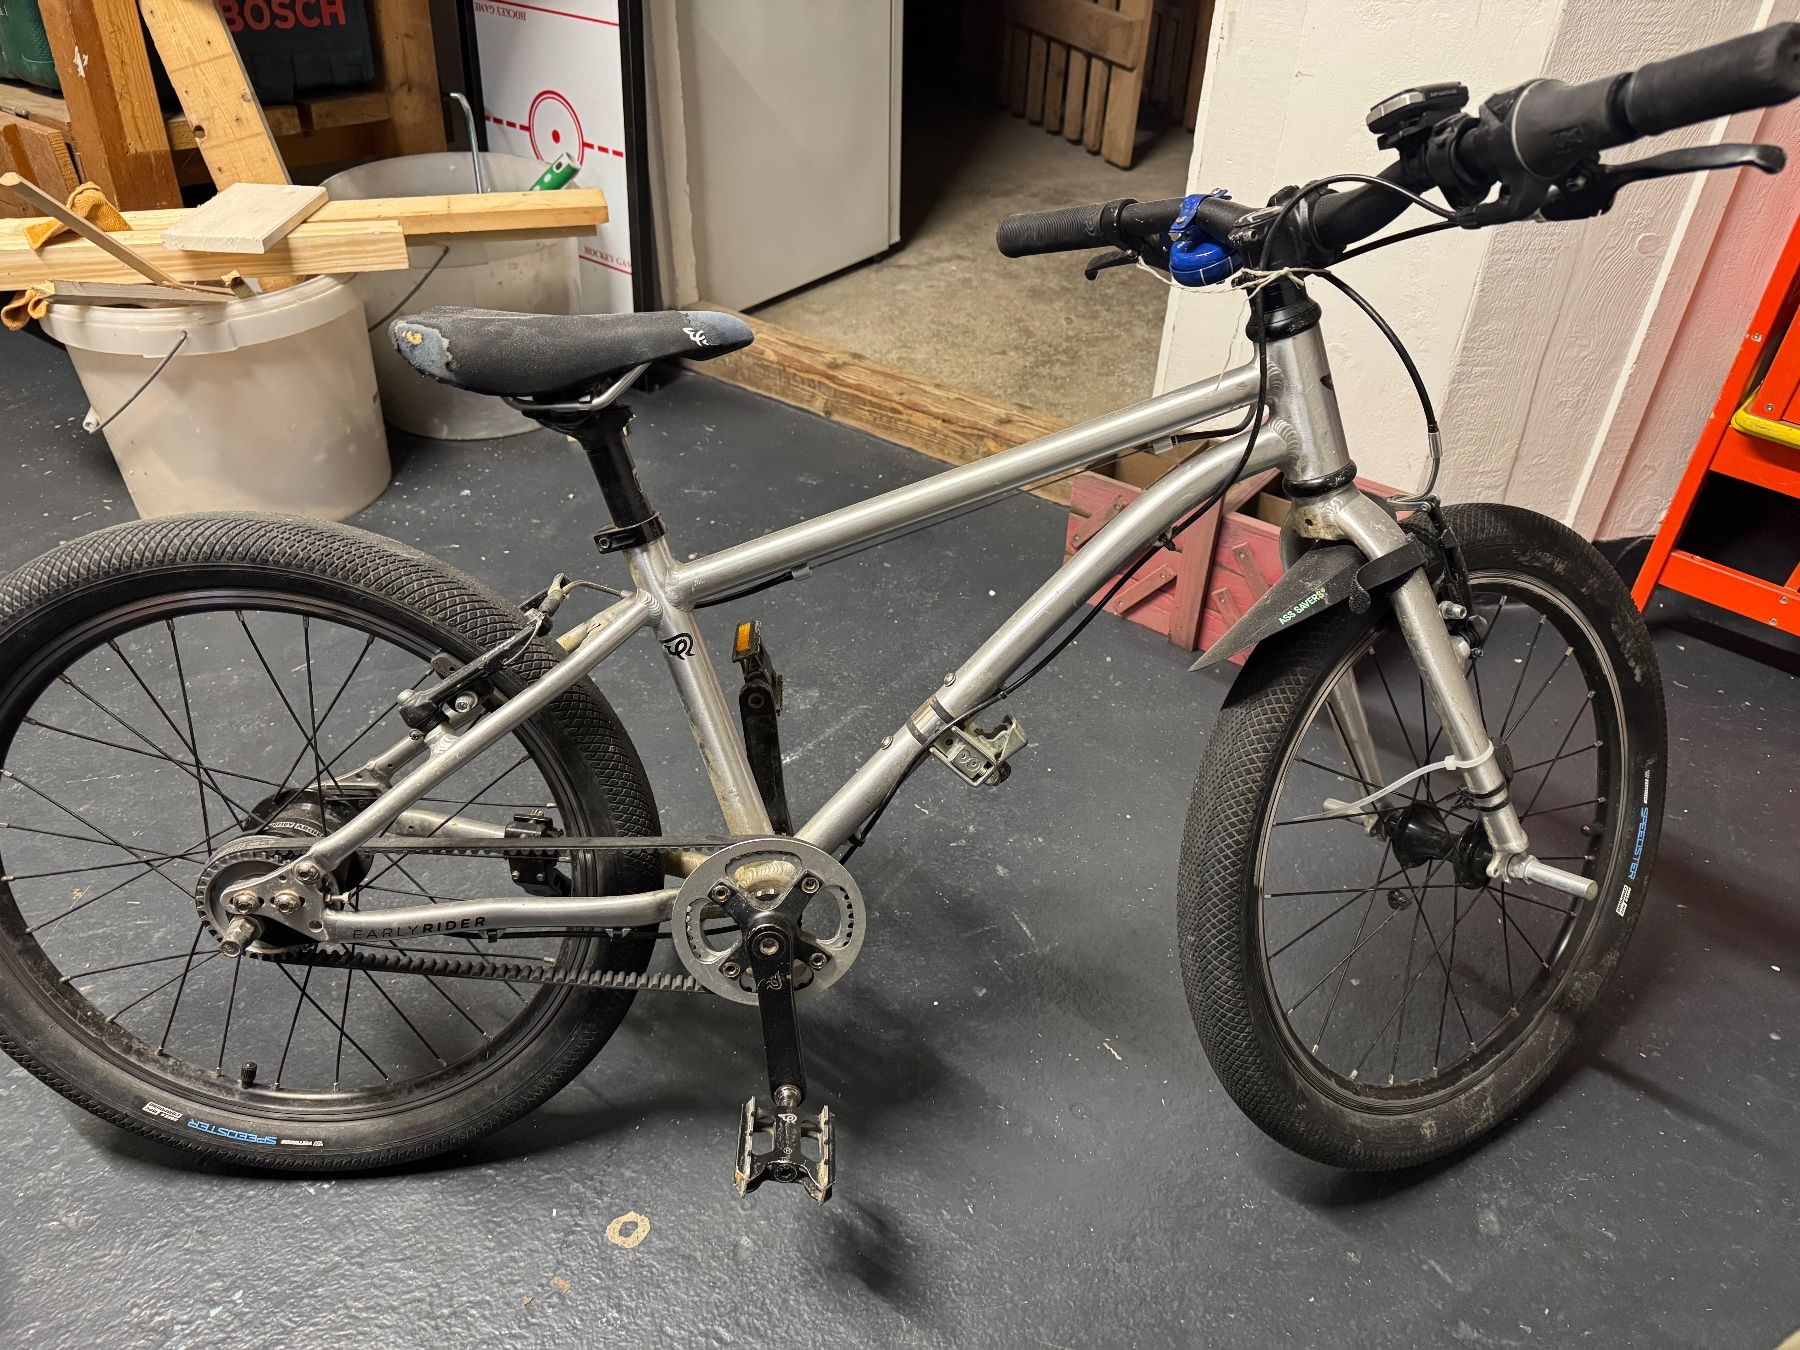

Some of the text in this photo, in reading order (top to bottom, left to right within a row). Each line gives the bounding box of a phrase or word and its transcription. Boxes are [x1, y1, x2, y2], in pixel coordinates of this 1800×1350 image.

[220, 0, 346, 31] BOSCH
[474, 2, 527, 20] HOCKEY GAME
[584, 245, 614, 263] HOCKEY
[1279, 610, 1296, 625] ASS
[1628, 806, 1649, 881] SPEEDSTER
[187, 1119, 277, 1146] SPEEDSTER
